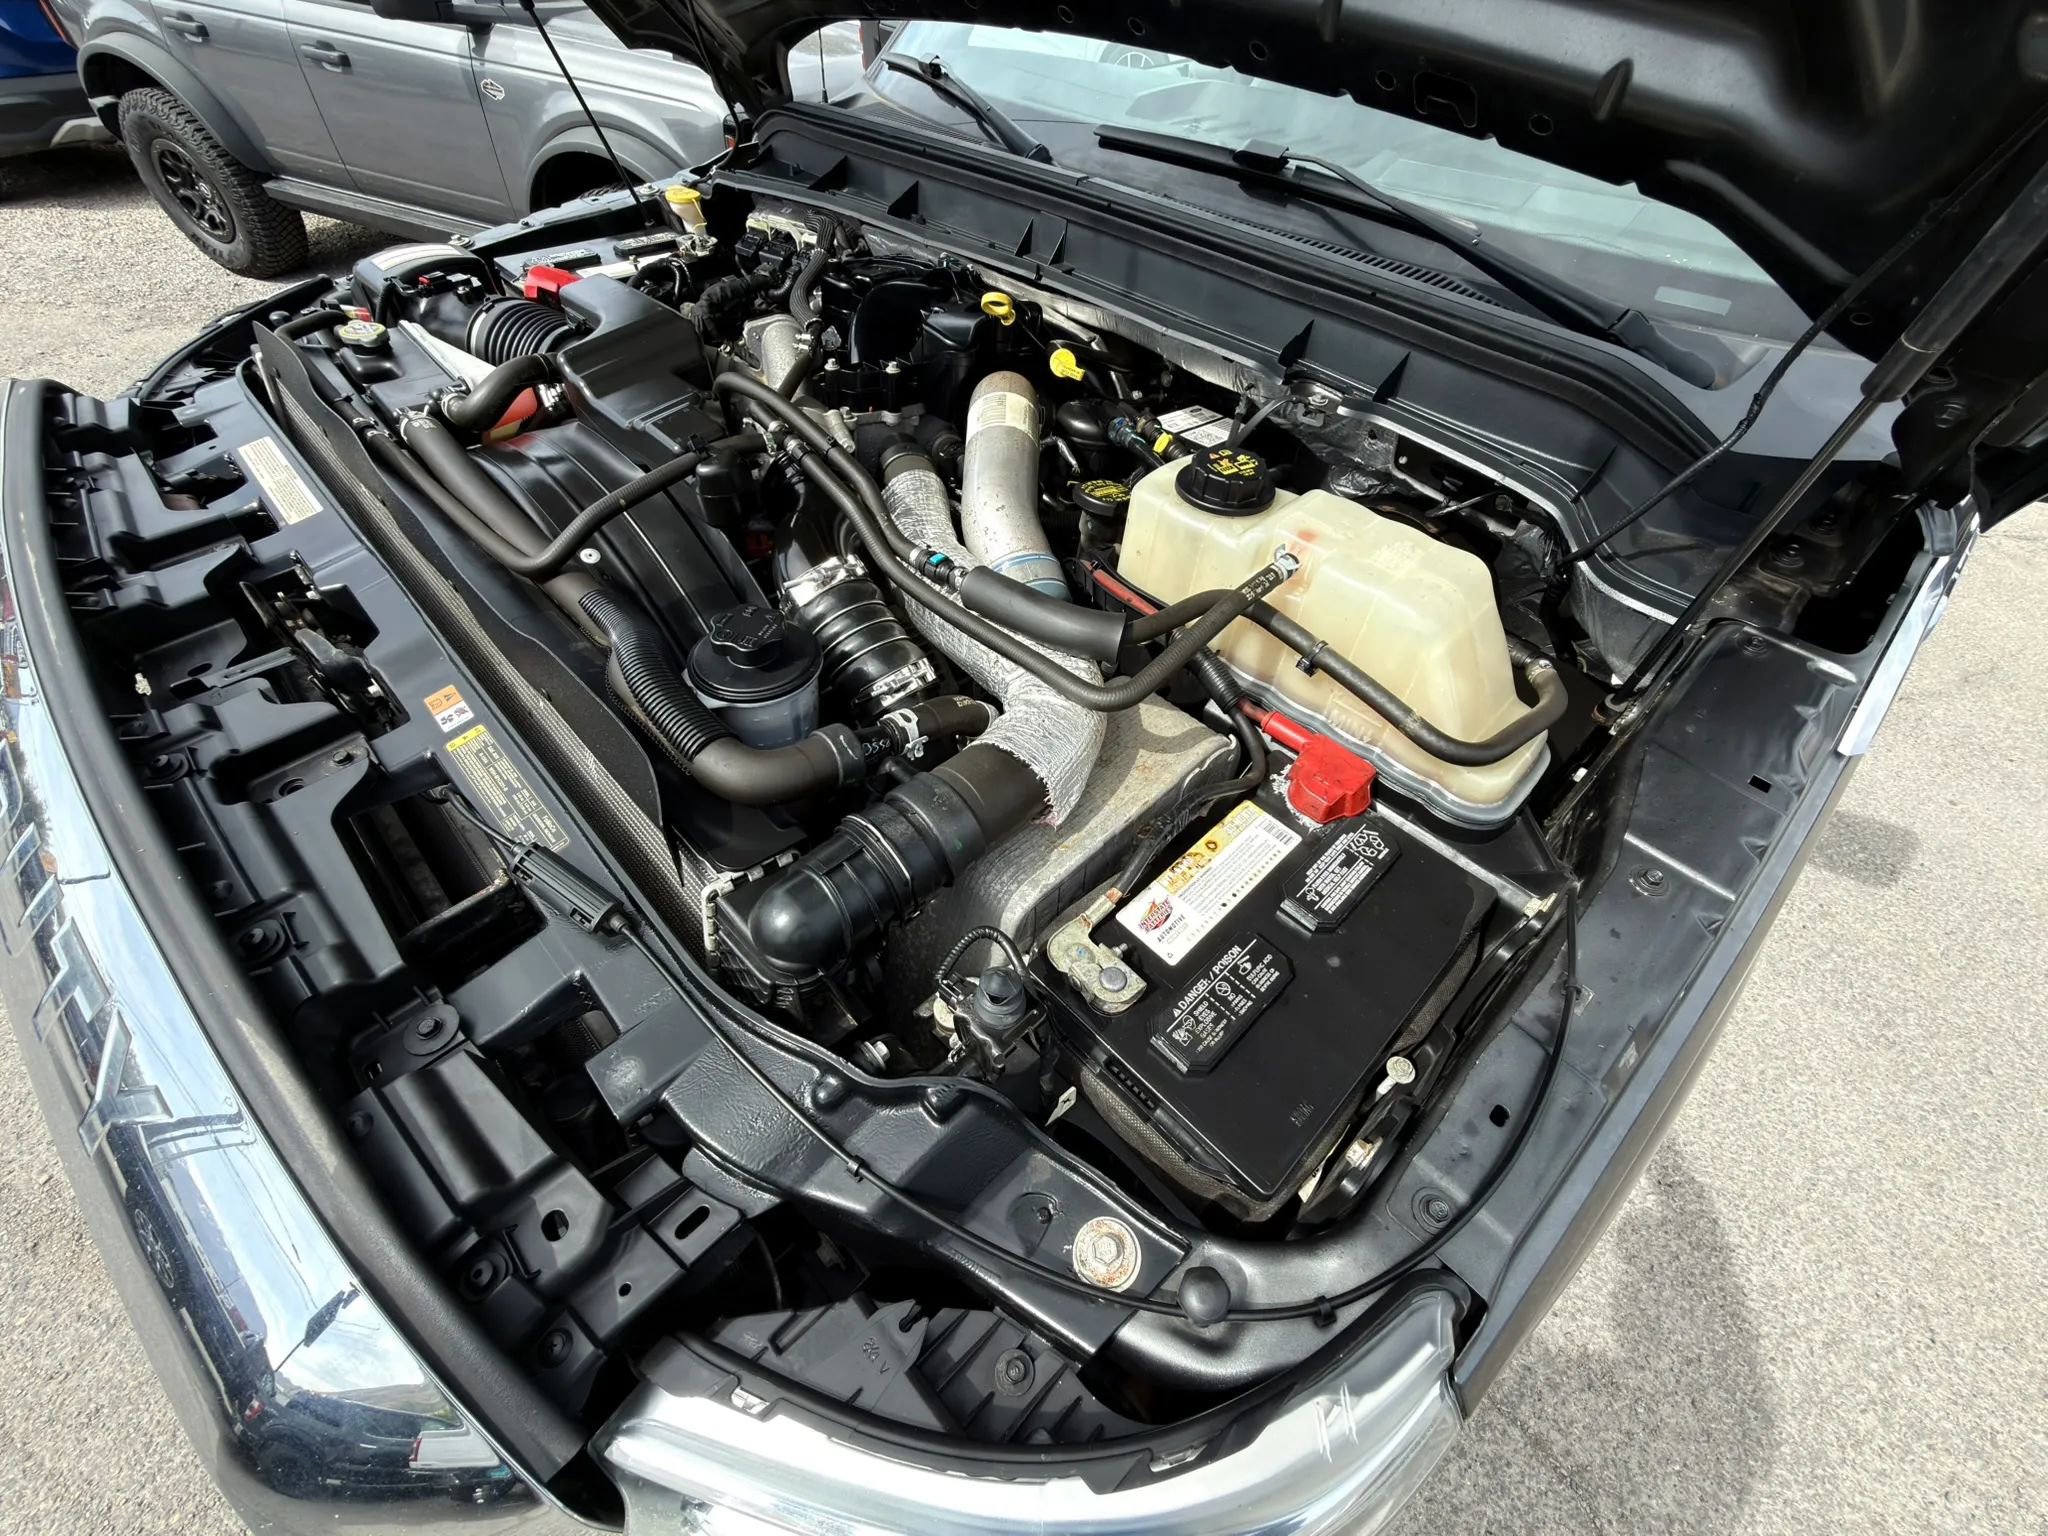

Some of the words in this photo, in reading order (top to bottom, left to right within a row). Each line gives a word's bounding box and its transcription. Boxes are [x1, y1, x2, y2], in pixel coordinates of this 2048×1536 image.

[1138, 898, 1170, 929] INTERSTATE
[1143, 904, 1173, 932] BATTERIES
[1156, 913, 1186, 942] AUTOMOTIVE
[1211, 943, 1242, 975] POISON
[1192, 999, 1209, 1017] SHIELD
[1194, 1009, 1217, 1034] EXPLOSIVE
[1197, 1007, 1211, 1021] EYES
